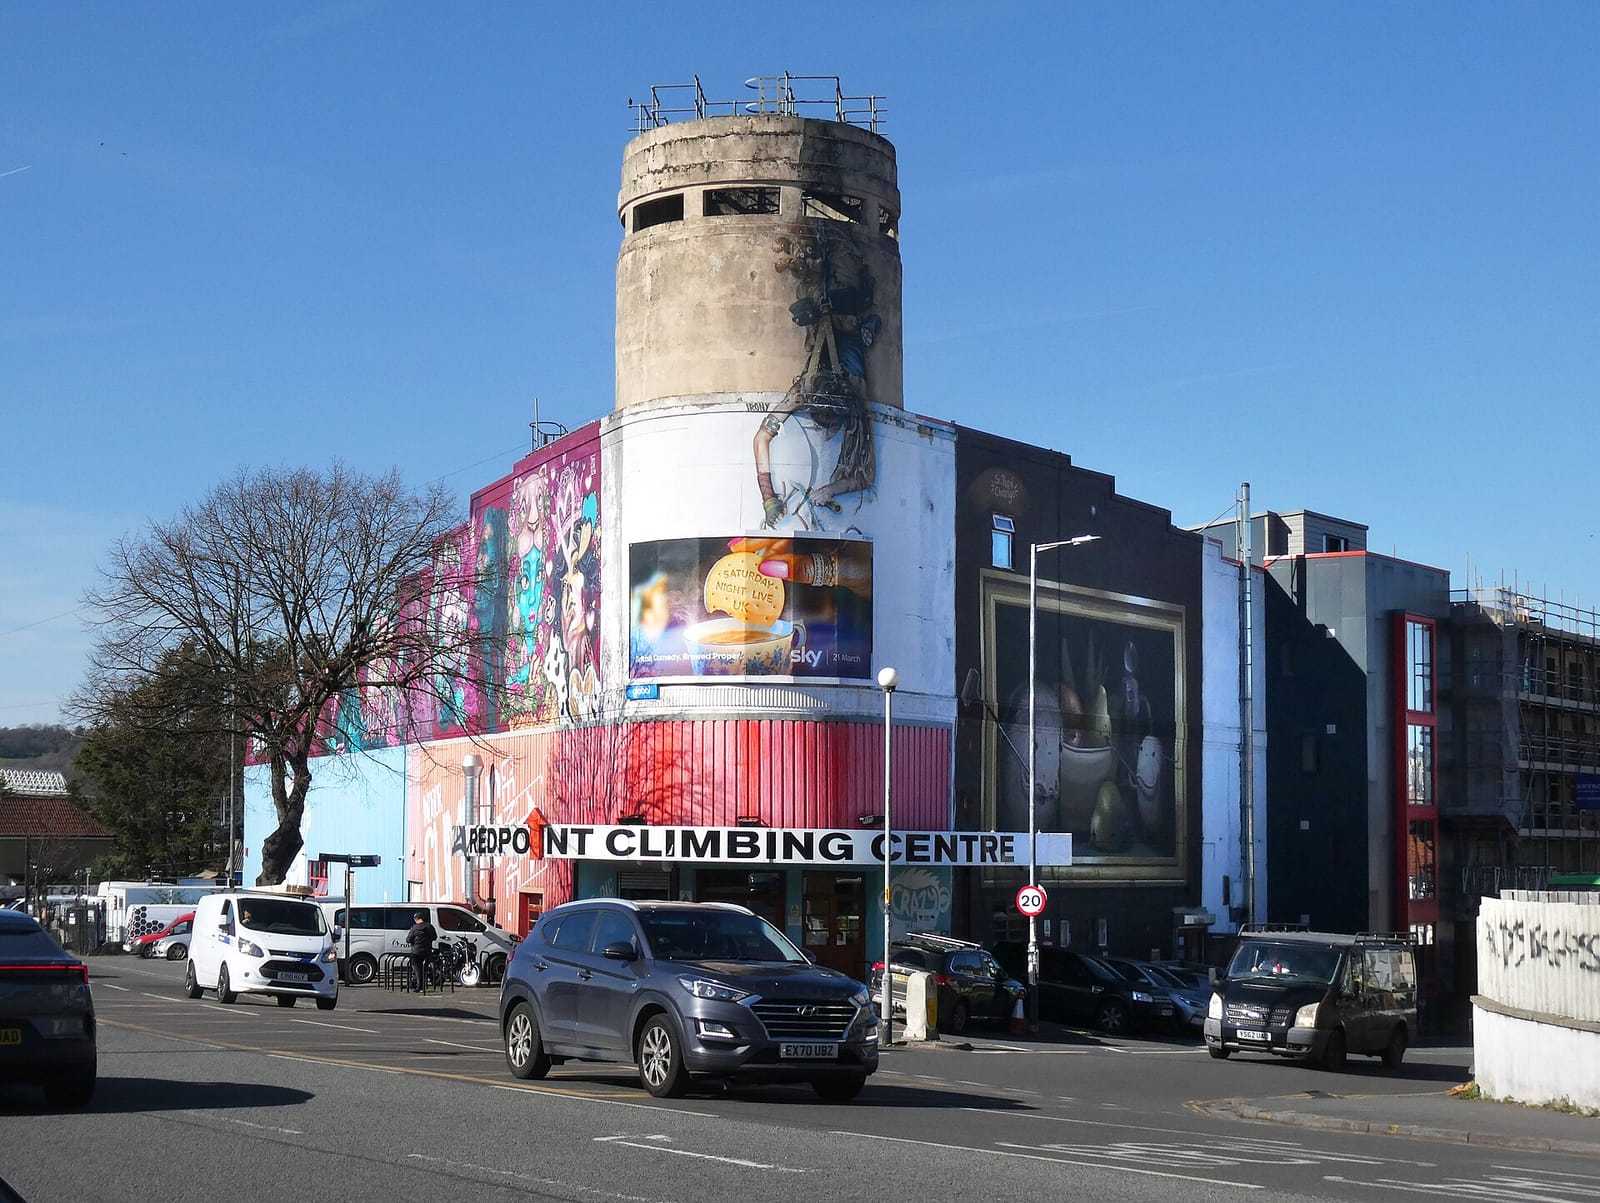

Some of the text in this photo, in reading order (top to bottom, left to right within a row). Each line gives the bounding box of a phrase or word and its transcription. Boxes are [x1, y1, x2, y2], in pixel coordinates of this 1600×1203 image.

[745, 402, 770, 412] IRONY
[723, 569, 774, 589] SATURDAY
[715, 581, 774, 604] NIGHT LIVE
[732, 600, 750, 613] UK
[790, 646, 823, 667] sky
[841, 653, 861, 663] March
[605, 828, 854, 862] CLIMBING
[870, 832, 1015, 864] CENTRE
[1021, 894, 1041, 907] 20
[785, 1044, 812, 1056] EX70
